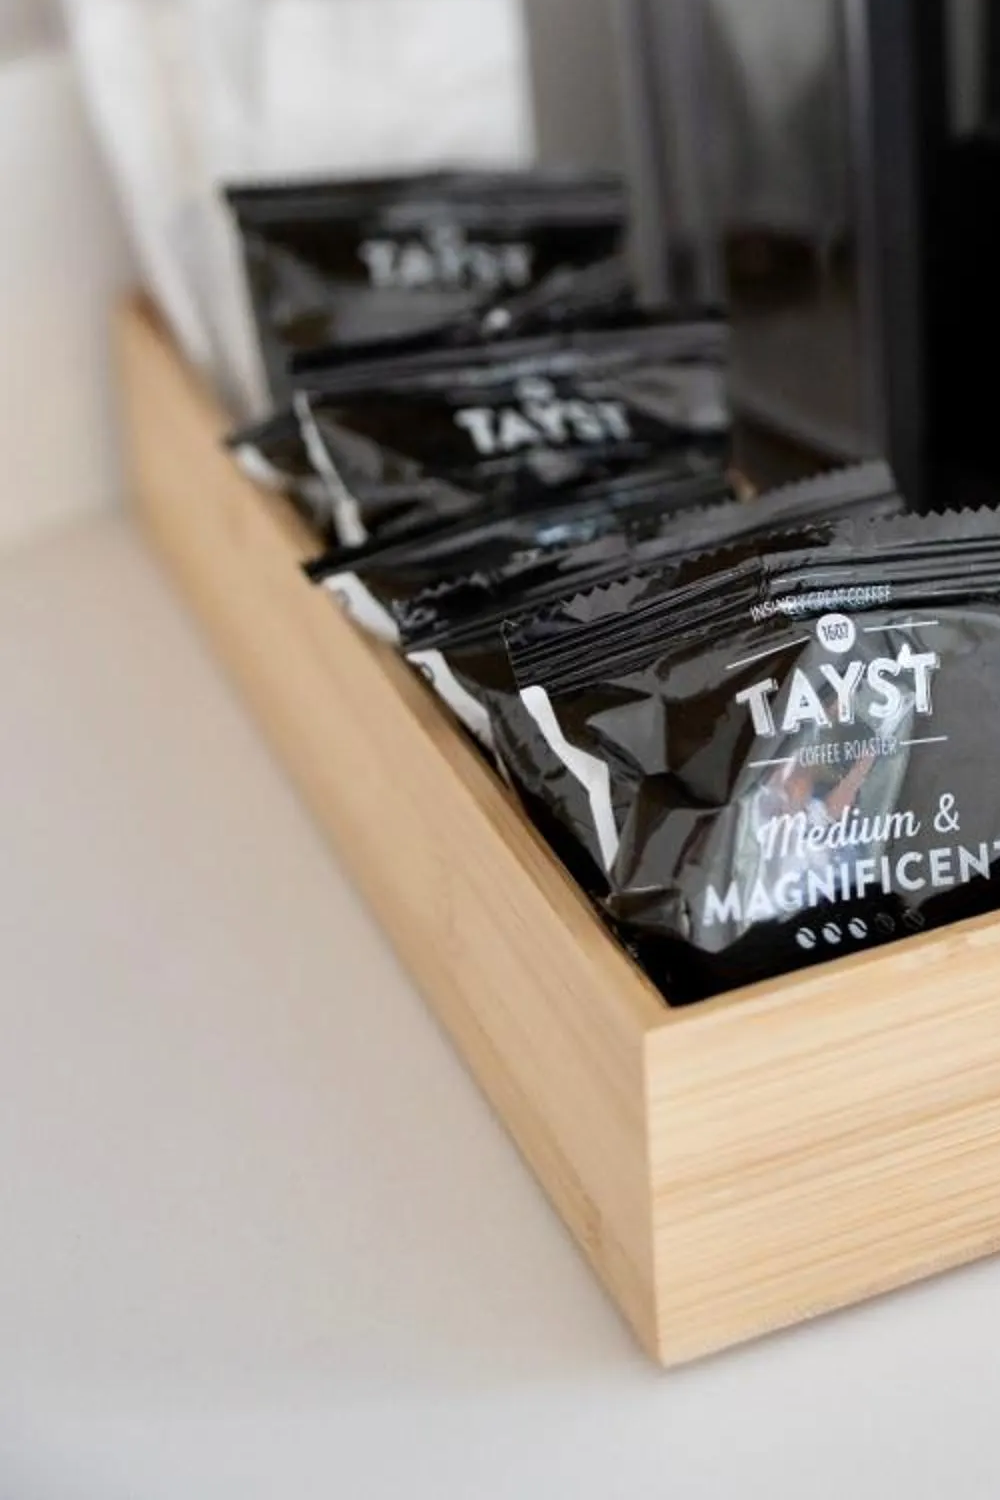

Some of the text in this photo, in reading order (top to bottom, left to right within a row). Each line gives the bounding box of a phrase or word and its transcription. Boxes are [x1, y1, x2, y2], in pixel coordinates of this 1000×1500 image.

[847, 585, 891, 605] COFFEE
[736, 651, 940, 736] TAYST
[799, 736, 897, 768] COFFEE ROASTER
[756, 793, 960, 861] Medium &
